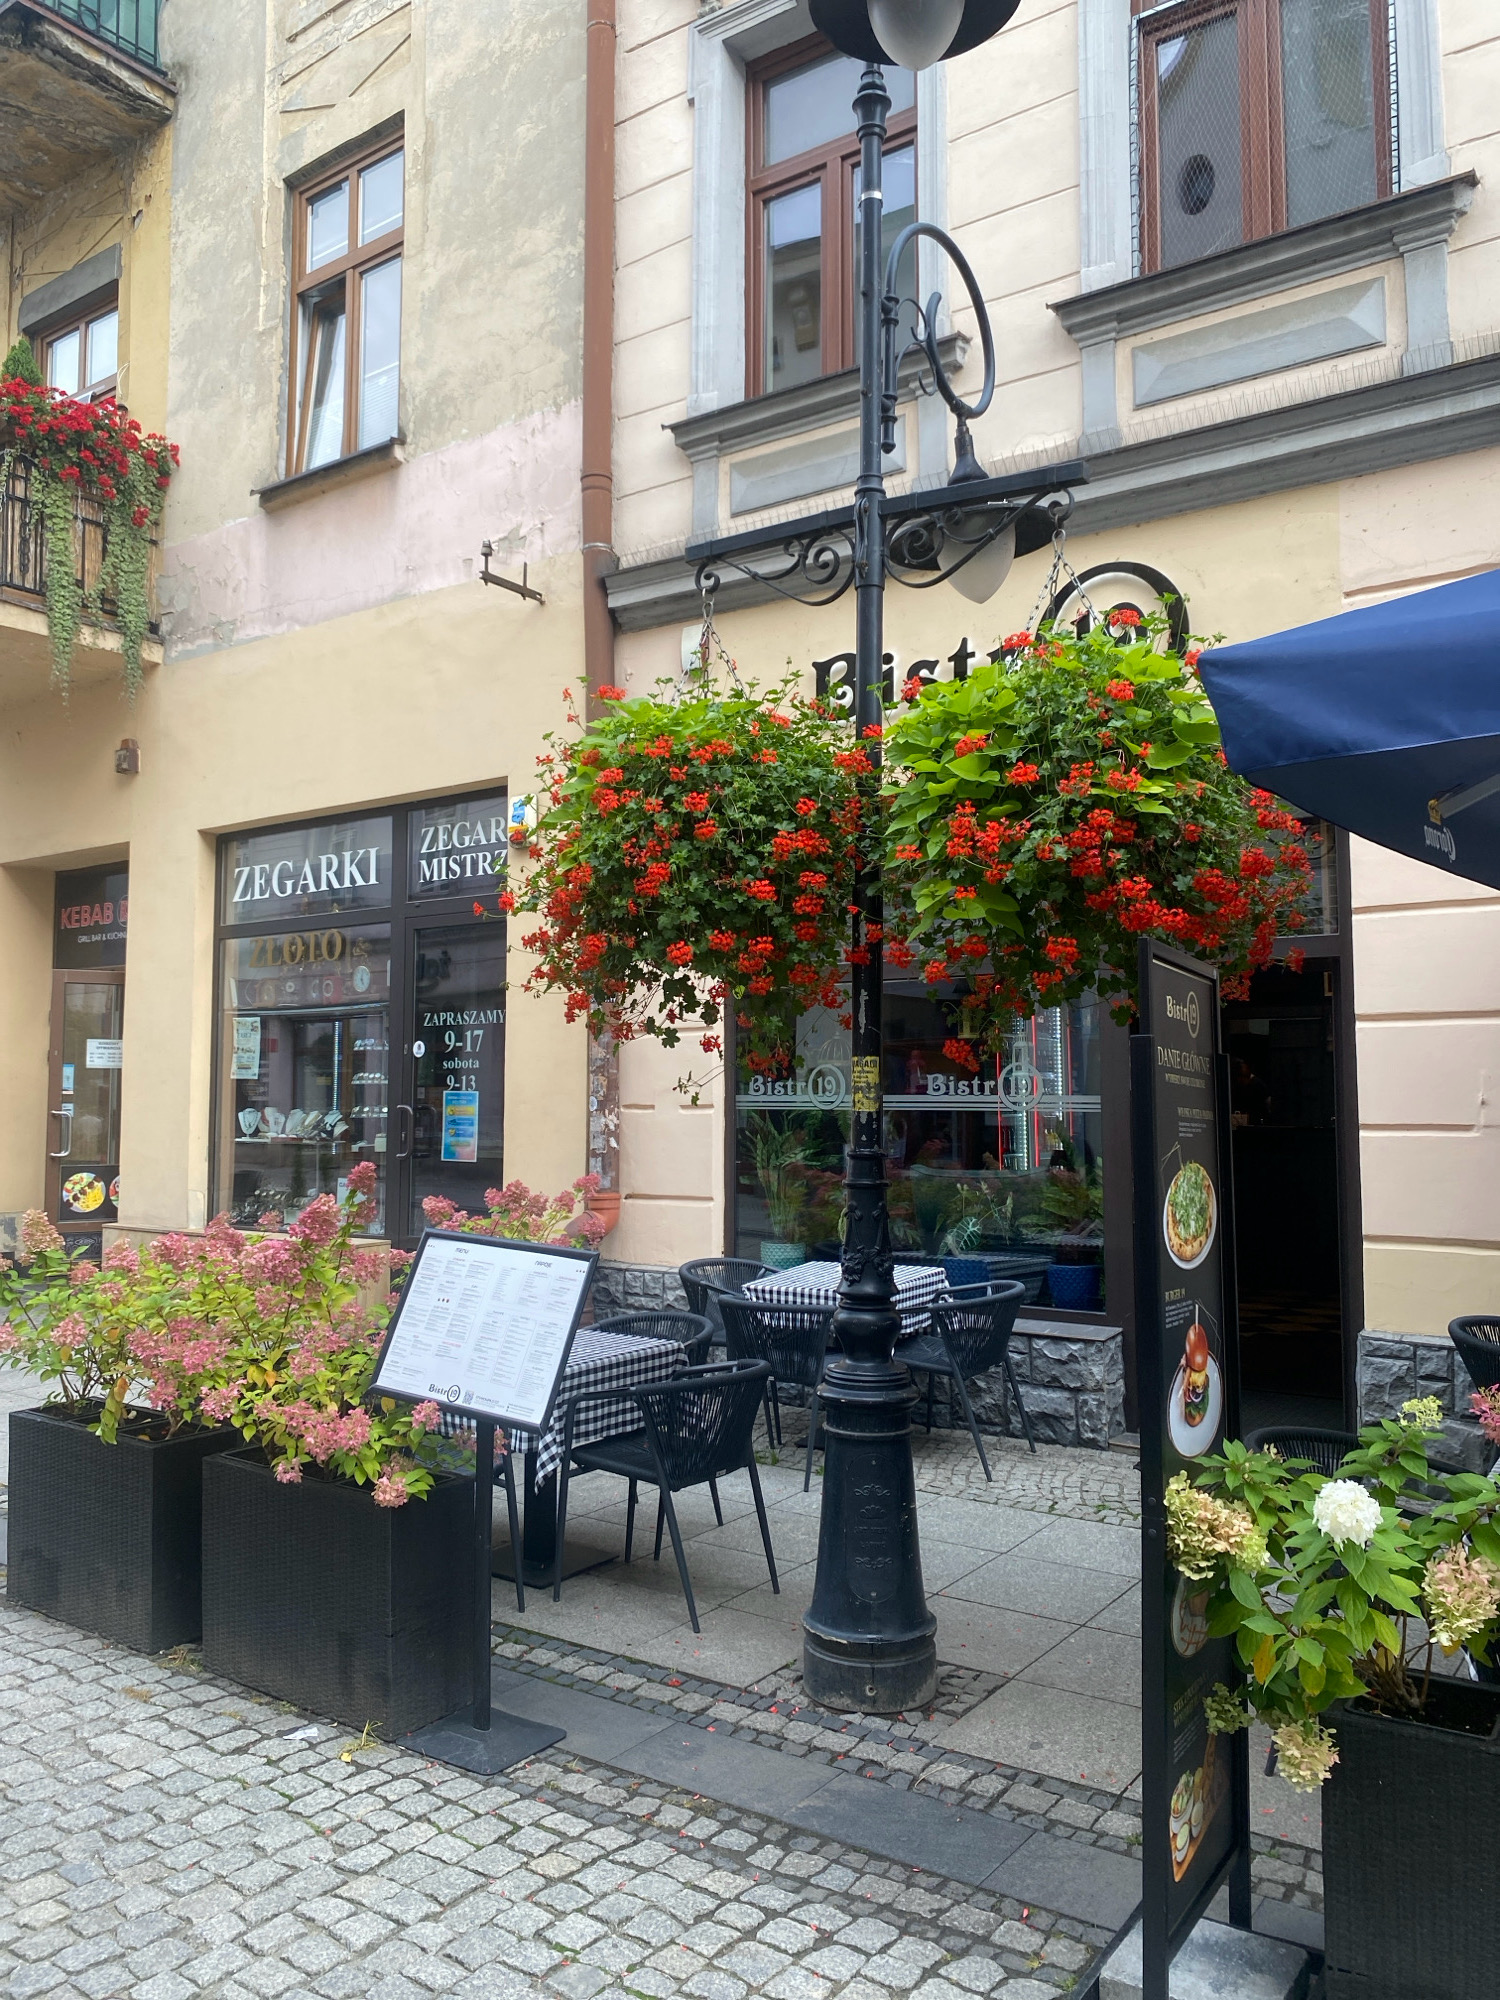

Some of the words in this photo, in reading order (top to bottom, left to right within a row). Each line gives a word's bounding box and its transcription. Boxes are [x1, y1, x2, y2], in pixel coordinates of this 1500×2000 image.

[421, 816, 507, 853] ZEGAR
[232, 847, 380, 903] ZEGARKI
[419, 849, 508, 883] MISTRZ
[61, 902, 113, 929] KEBAB
[423, 1009, 506, 1027] ZAPRASZAMY
[444, 1030, 484, 1053] 9-17
[443, 1057, 480, 1069] sobota
[1157, 1046, 1181, 1069] DANIE
[446, 1074, 476, 1091] 9-13
[748, 1074, 808, 1096] Bistr
[926, 1073, 996, 1096] Bistr
